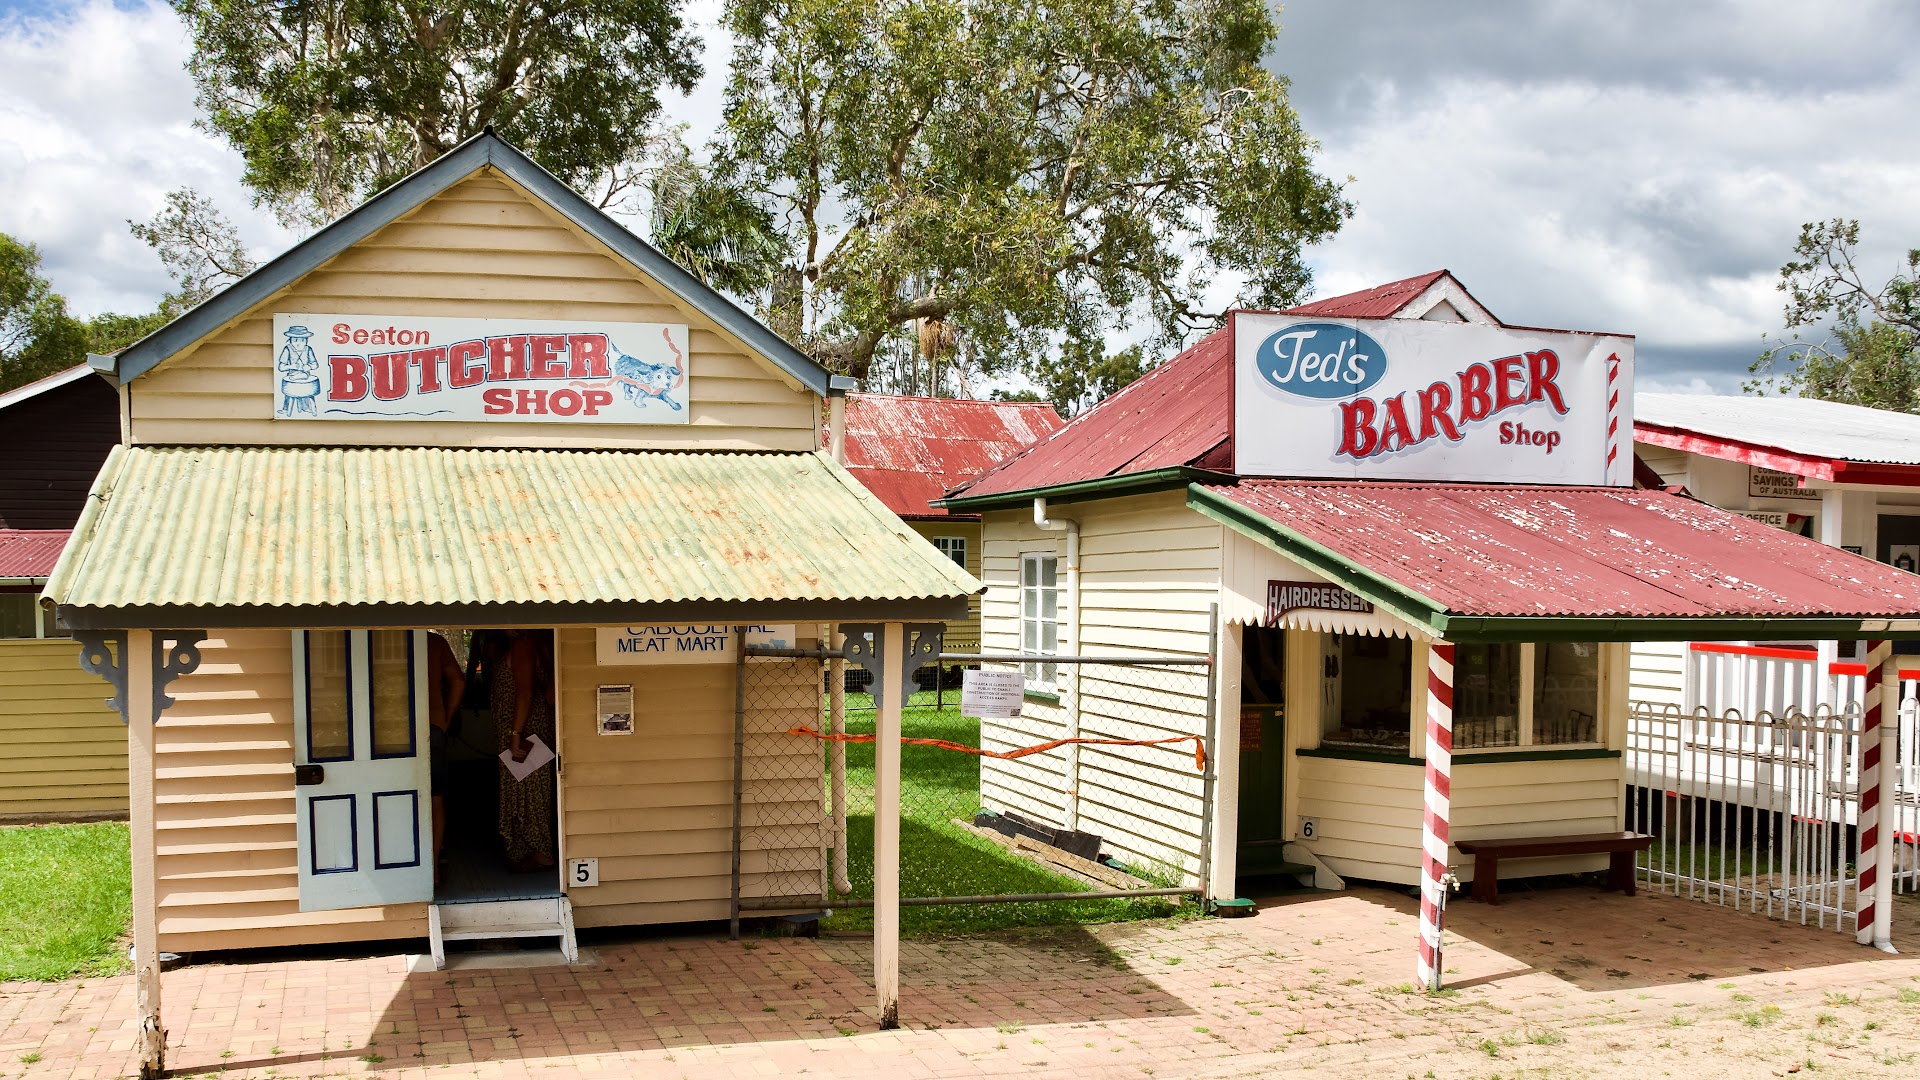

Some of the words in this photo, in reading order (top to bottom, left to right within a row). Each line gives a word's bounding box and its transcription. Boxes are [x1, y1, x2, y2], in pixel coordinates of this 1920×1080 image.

[331, 323, 431, 346] Seaton
[327, 332, 612, 402] BUTCHER
[1272, 330, 1369, 384] Ted's
[482, 388, 614, 416] SHOP
[1336, 349, 1570, 459] BARBER
[1499, 421, 1561, 455] Shop
[1753, 475, 1794, 486] SAVINGS
[1772, 487, 1817, 497] AUSTRALIA
[1268, 585, 1369, 622] HAIRDRESSER
[617, 637, 670, 653] MEAT
[675, 636, 729, 651] MART
[1303, 822, 1313, 837] 6
[577, 863, 589, 882] 5
